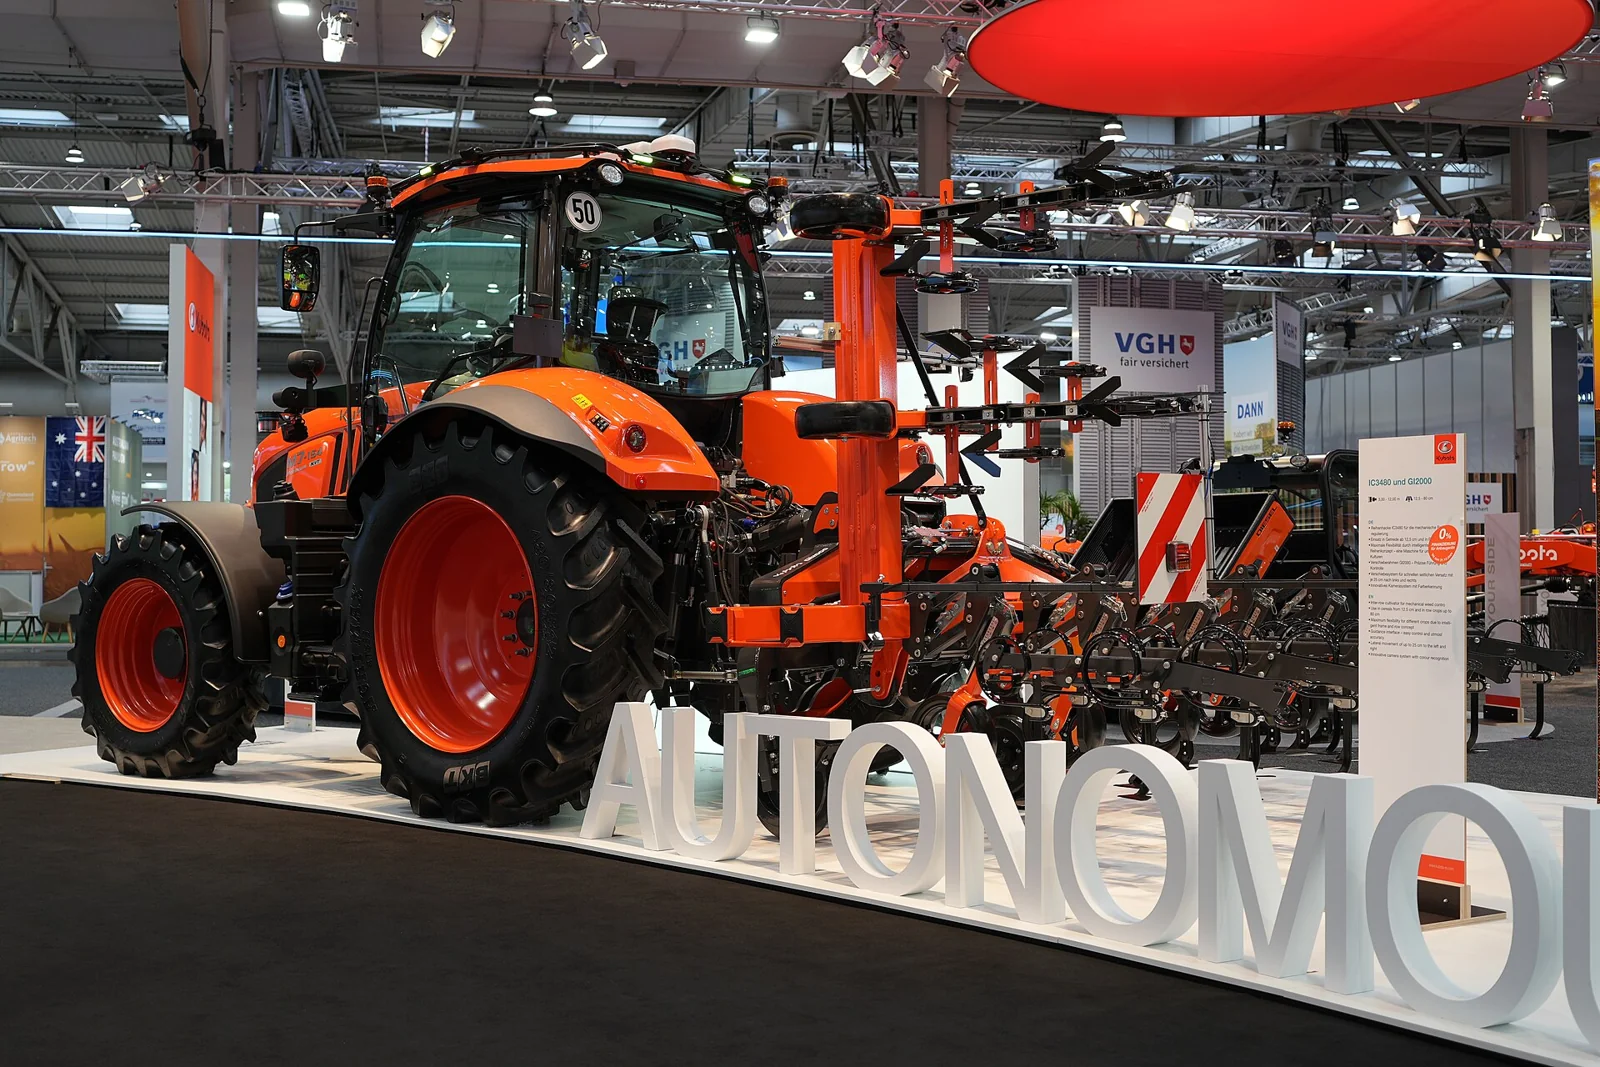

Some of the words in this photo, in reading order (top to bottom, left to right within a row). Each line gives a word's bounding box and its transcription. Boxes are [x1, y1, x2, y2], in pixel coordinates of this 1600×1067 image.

[572, 198, 595, 225] 50
[658, 340, 688, 360] GH
[1114, 332, 1174, 354] VGH
[1120, 357, 1138, 367] fair
[1140, 358, 1189, 368] versichert
[1238, 401, 1264, 419] DANN
[5, 434, 37, 444] Agritech
[0, 463, 27, 472] row
[1408, 477, 1432, 485] GI2000
[1256, 507, 1278, 536] DIESEL
[1439, 528, 1452, 539] 0%
[442, 761, 492, 794] BKT
[579, 701, 1600, 1047] AUTONOMO
